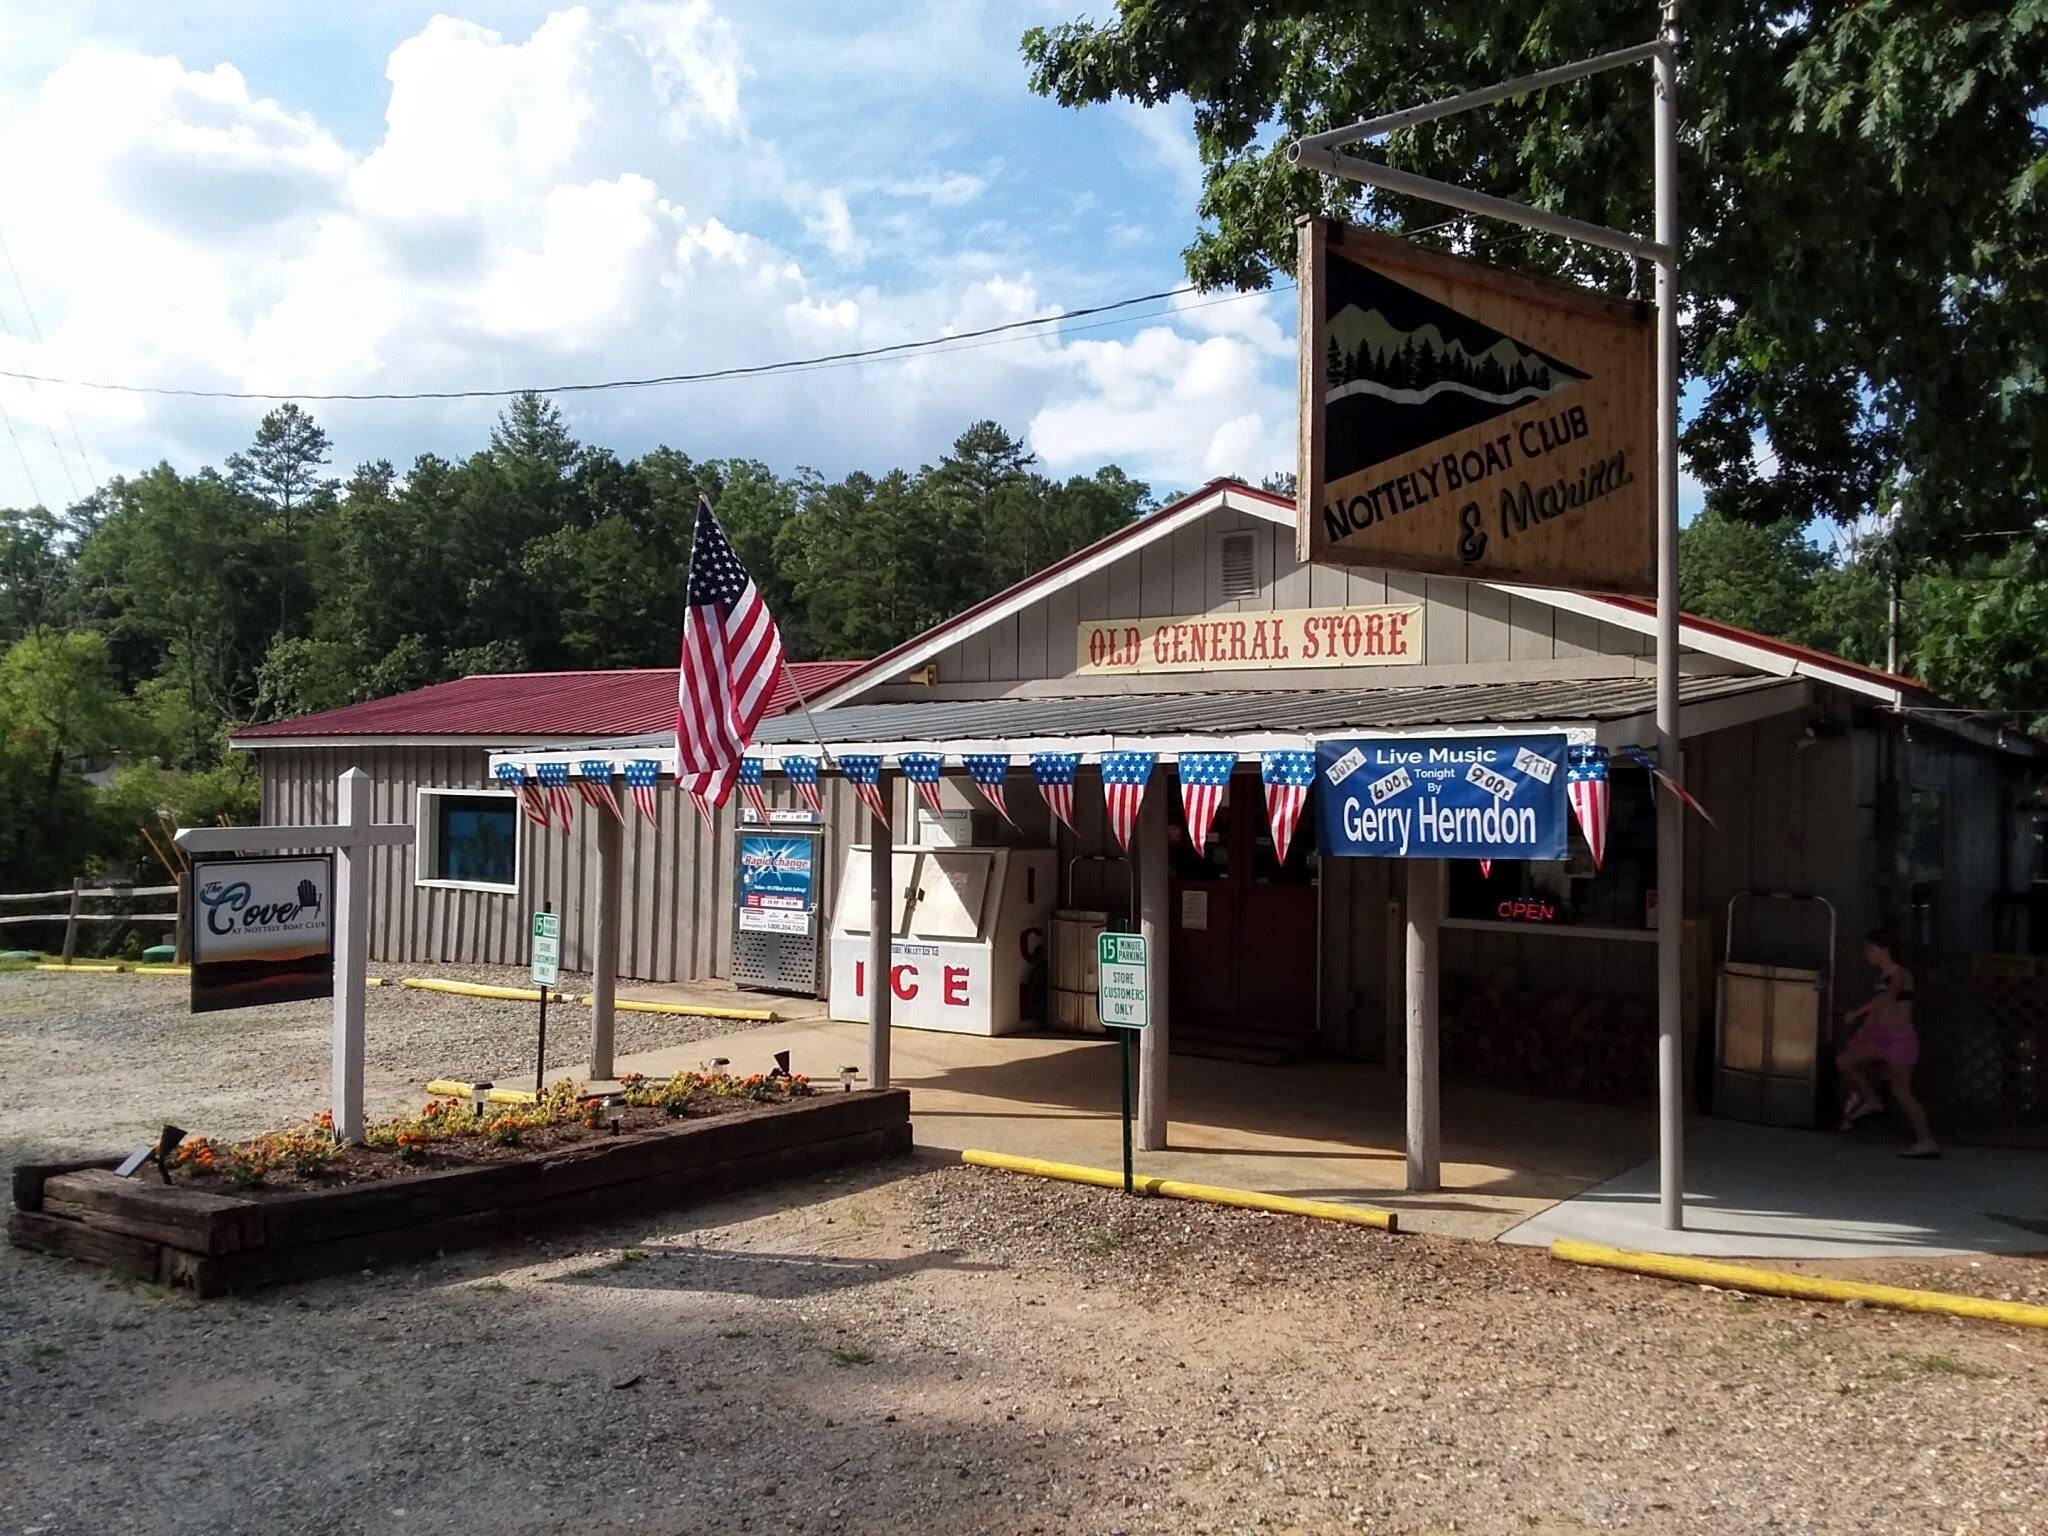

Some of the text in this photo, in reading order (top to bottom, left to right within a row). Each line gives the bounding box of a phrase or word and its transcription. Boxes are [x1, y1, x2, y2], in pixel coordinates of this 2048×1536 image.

[1324, 405, 1589, 542] NOTTELY BOAT CLUB
[1458, 450, 1634, 565] & Marina
[1089, 612, 1408, 667] OLD GENERAL STORE
[1377, 747, 1497, 764] Live Music
[1414, 768, 1456, 780] Tonight
[1427, 783, 1442, 795] By
[1344, 795, 1536, 856] Gerry Herndon
[205, 881, 223, 894] The
[199, 881, 295, 935] Cove
[1498, 901, 1554, 920] OPEN
[243, 924, 280, 935] NOTTELY
[283, 923, 303, 931] BOAT
[306, 921, 326, 929] CLUB
[535, 917, 543, 932] 15
[1102, 938, 1142, 960] 15 MINUTE
[1119, 950, 1143, 962] PARKING
[856, 960, 970, 1006] ICE
[1113, 971, 1134, 985] STORE
[1104, 986, 1144, 1001] CUSTOMERS
[1114, 1003, 1133, 1015] ONLY
